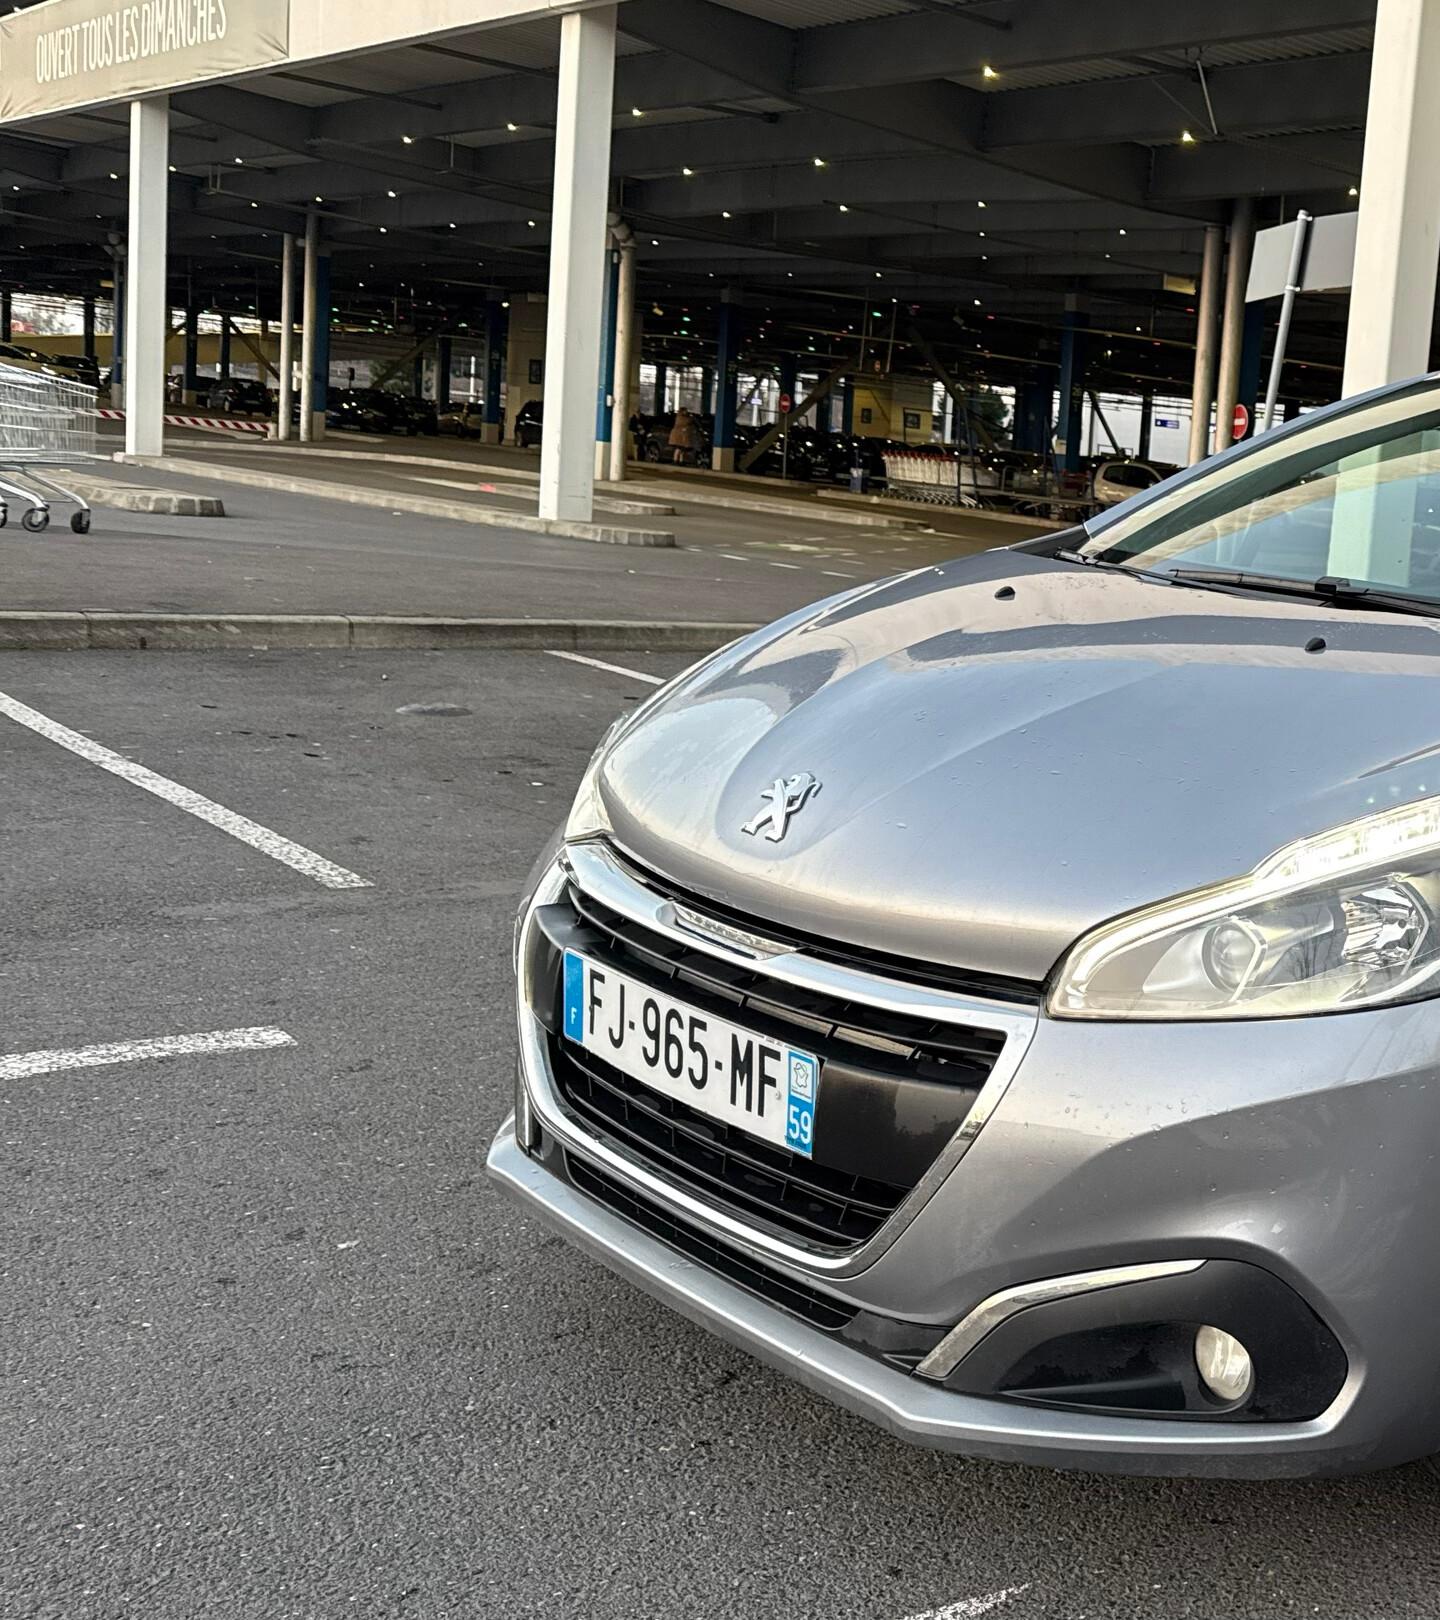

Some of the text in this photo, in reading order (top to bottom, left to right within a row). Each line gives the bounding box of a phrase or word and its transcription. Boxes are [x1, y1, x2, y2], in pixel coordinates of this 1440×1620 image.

[36, 0, 227, 84] OUVERT TOUS LES DIMANCHES
[588, 967, 782, 1118] FJ-965-MF
[788, 1103, 812, 1145] 59
